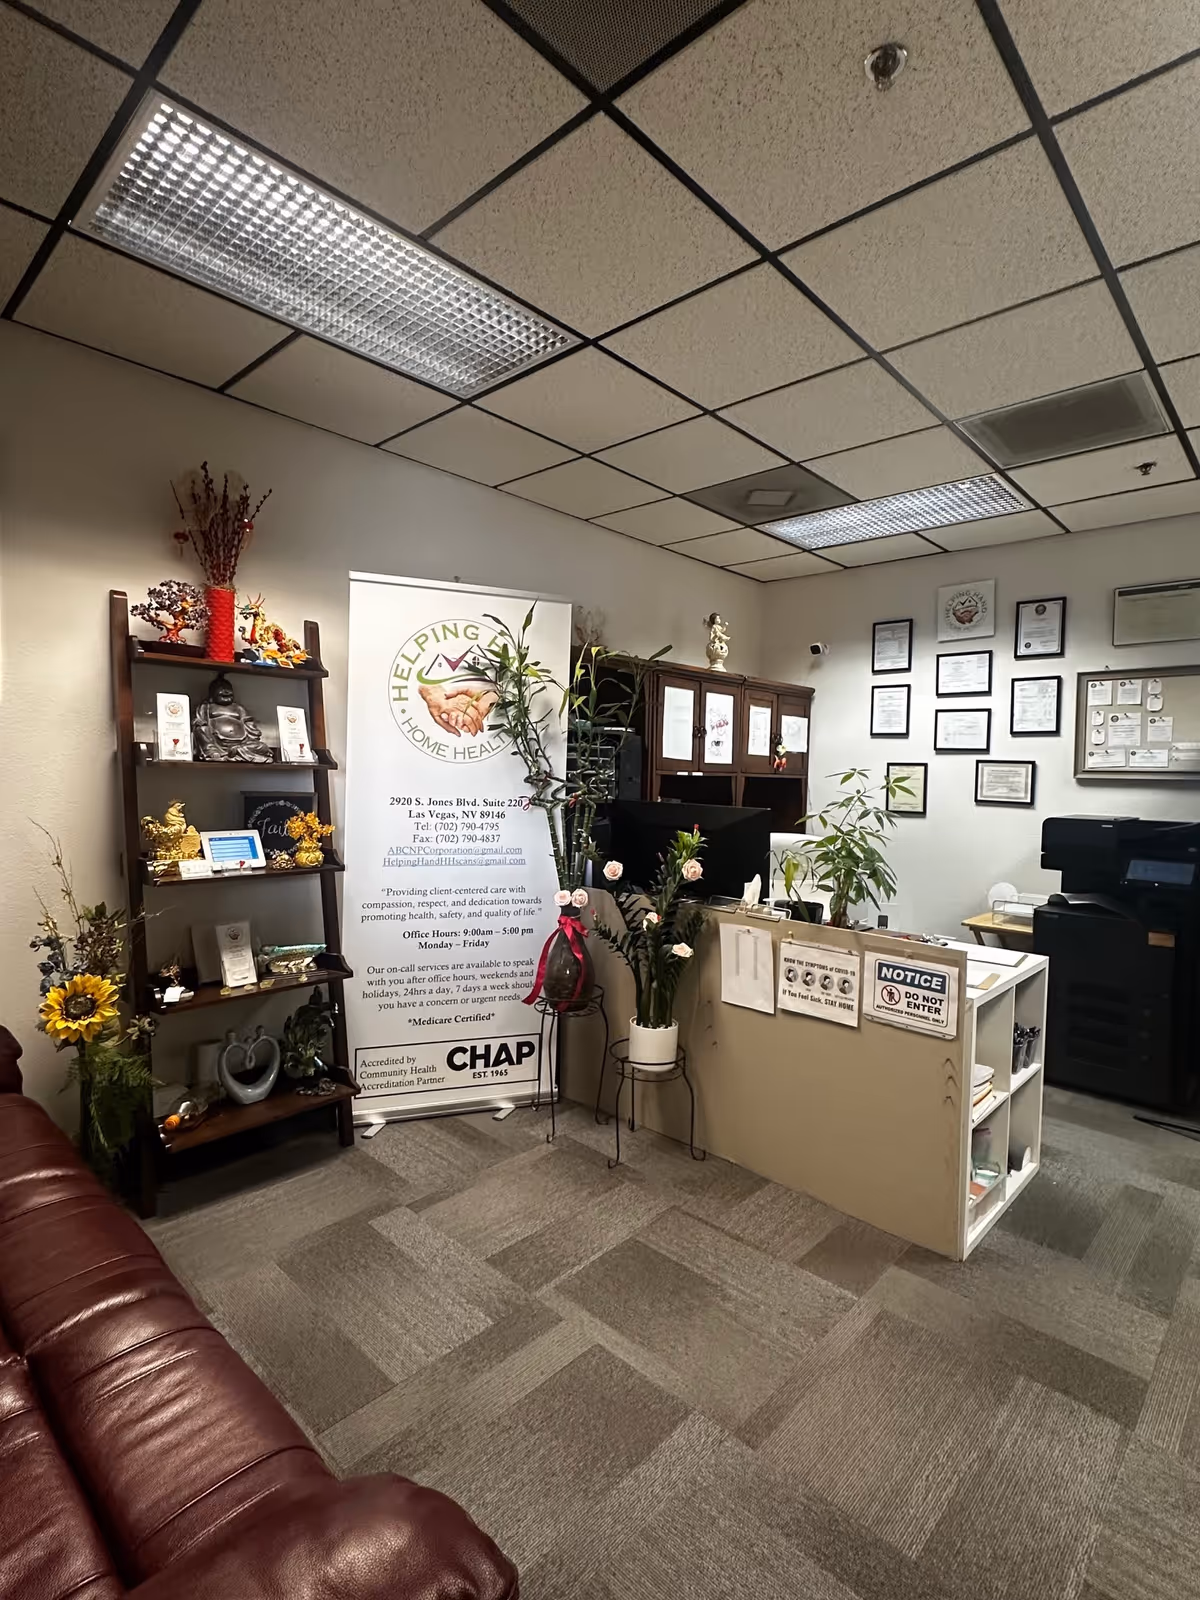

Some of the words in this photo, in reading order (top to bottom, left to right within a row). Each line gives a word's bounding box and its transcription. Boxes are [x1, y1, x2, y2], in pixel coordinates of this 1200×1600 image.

[392, 623, 480, 702] HELPING
[401, 716, 449, 758] HOME
[453, 729, 509, 760] HEALT
[390, 797, 412, 806] 2920
[415, 798, 424, 806] S.
[427, 798, 453, 807] Jones
[456, 798, 479, 807] Blvd.
[483, 798, 505, 807] Suite
[508, 799, 523, 808] 220
[409, 810, 425, 819] Las
[429, 811, 459, 820] Vegas,
[462, 811, 477, 819] NV
[480, 811, 505, 819] 89146
[414, 822, 431, 831] Tel:
[434, 822, 457, 832] (702)
[461, 822, 499, 831] 790-4795
[413, 834, 433, 843] Fax:
[436, 835, 459, 844] (702)
[462, 834, 500, 843] 790-4837
[430, 886, 488, 896] client-centered
[508, 886, 526, 894] with
[362, 901, 415, 911] compassion,
[418, 899, 448, 909] respect,
[451, 898, 466, 906] and
[468, 897, 509, 906] dedication
[511, 897, 542, 905] towards
[361, 913, 406, 923] promoting
[409, 911, 436, 920] health,
[439, 910, 464, 920] safety,
[467, 909, 482, 918] and
[485, 908, 511, 918] quality
[513, 908, 521, 916] of
[403, 931, 429, 939] Office
[432, 929, 460, 938] Hours:
[463, 928, 493, 937] 9:00am
[502, 927, 519, 935] 5:00
[521, 927, 533, 936] pm
[418, 941, 453, 950] Monday
[463, 940, 489, 948] Friday
[367, 965, 384, 975] Our
[387, 964, 415, 973] on-call
[418, 964, 449, 972] services
[466, 960, 501, 969] available
[513, 958, 534, 970] speak
[367, 978, 386, 986] with
[388, 978, 404, 987] you
[407, 975, 426, 984] after
[428, 974, 450, 983] office
[452, 972, 477, 982] hours,
[480, 970, 518, 980] weekends
[520, 969, 534, 977] and
[881, 967, 942, 990] NOTICE
[363, 990, 401, 999] holidays,
[404, 987, 426, 996] 24hrs
[436, 986, 453, 995] day,
[456, 984, 460, 993] 7
[463, 984, 481, 993] days
[490, 982, 510, 990] week
[512, 981, 534, 989] shoul
[378, 1002, 394, 1011] you
[397, 999, 416, 1009] have
[426, 997, 458, 1006] concern
[471, 996, 496, 1005] urgent
[788, 989, 797, 997] You
[825, 999, 837, 1007] STAY
[839, 1002, 854, 1011] HOME
[905, 991, 919, 1000] DO
[923, 995, 944, 1006] NOT
[876, 1004, 903, 1014] AUTHORIZED
[904, 1010, 930, 1021] PERSONNEL
[907, 1001, 941, 1015] ENTER
[360, 1057, 405, 1068] Accredited
[407, 1056, 416, 1064] by
[446, 1041, 535, 1071] CHAP
[360, 1067, 408, 1079] Community
[410, 1065, 436, 1075] Health
[473, 1070, 488, 1079] EST.
[491, 1069, 508, 1077] 1965
[360, 1077, 415, 1091] Accreditation
[417, 1076, 445, 1085] Partner
